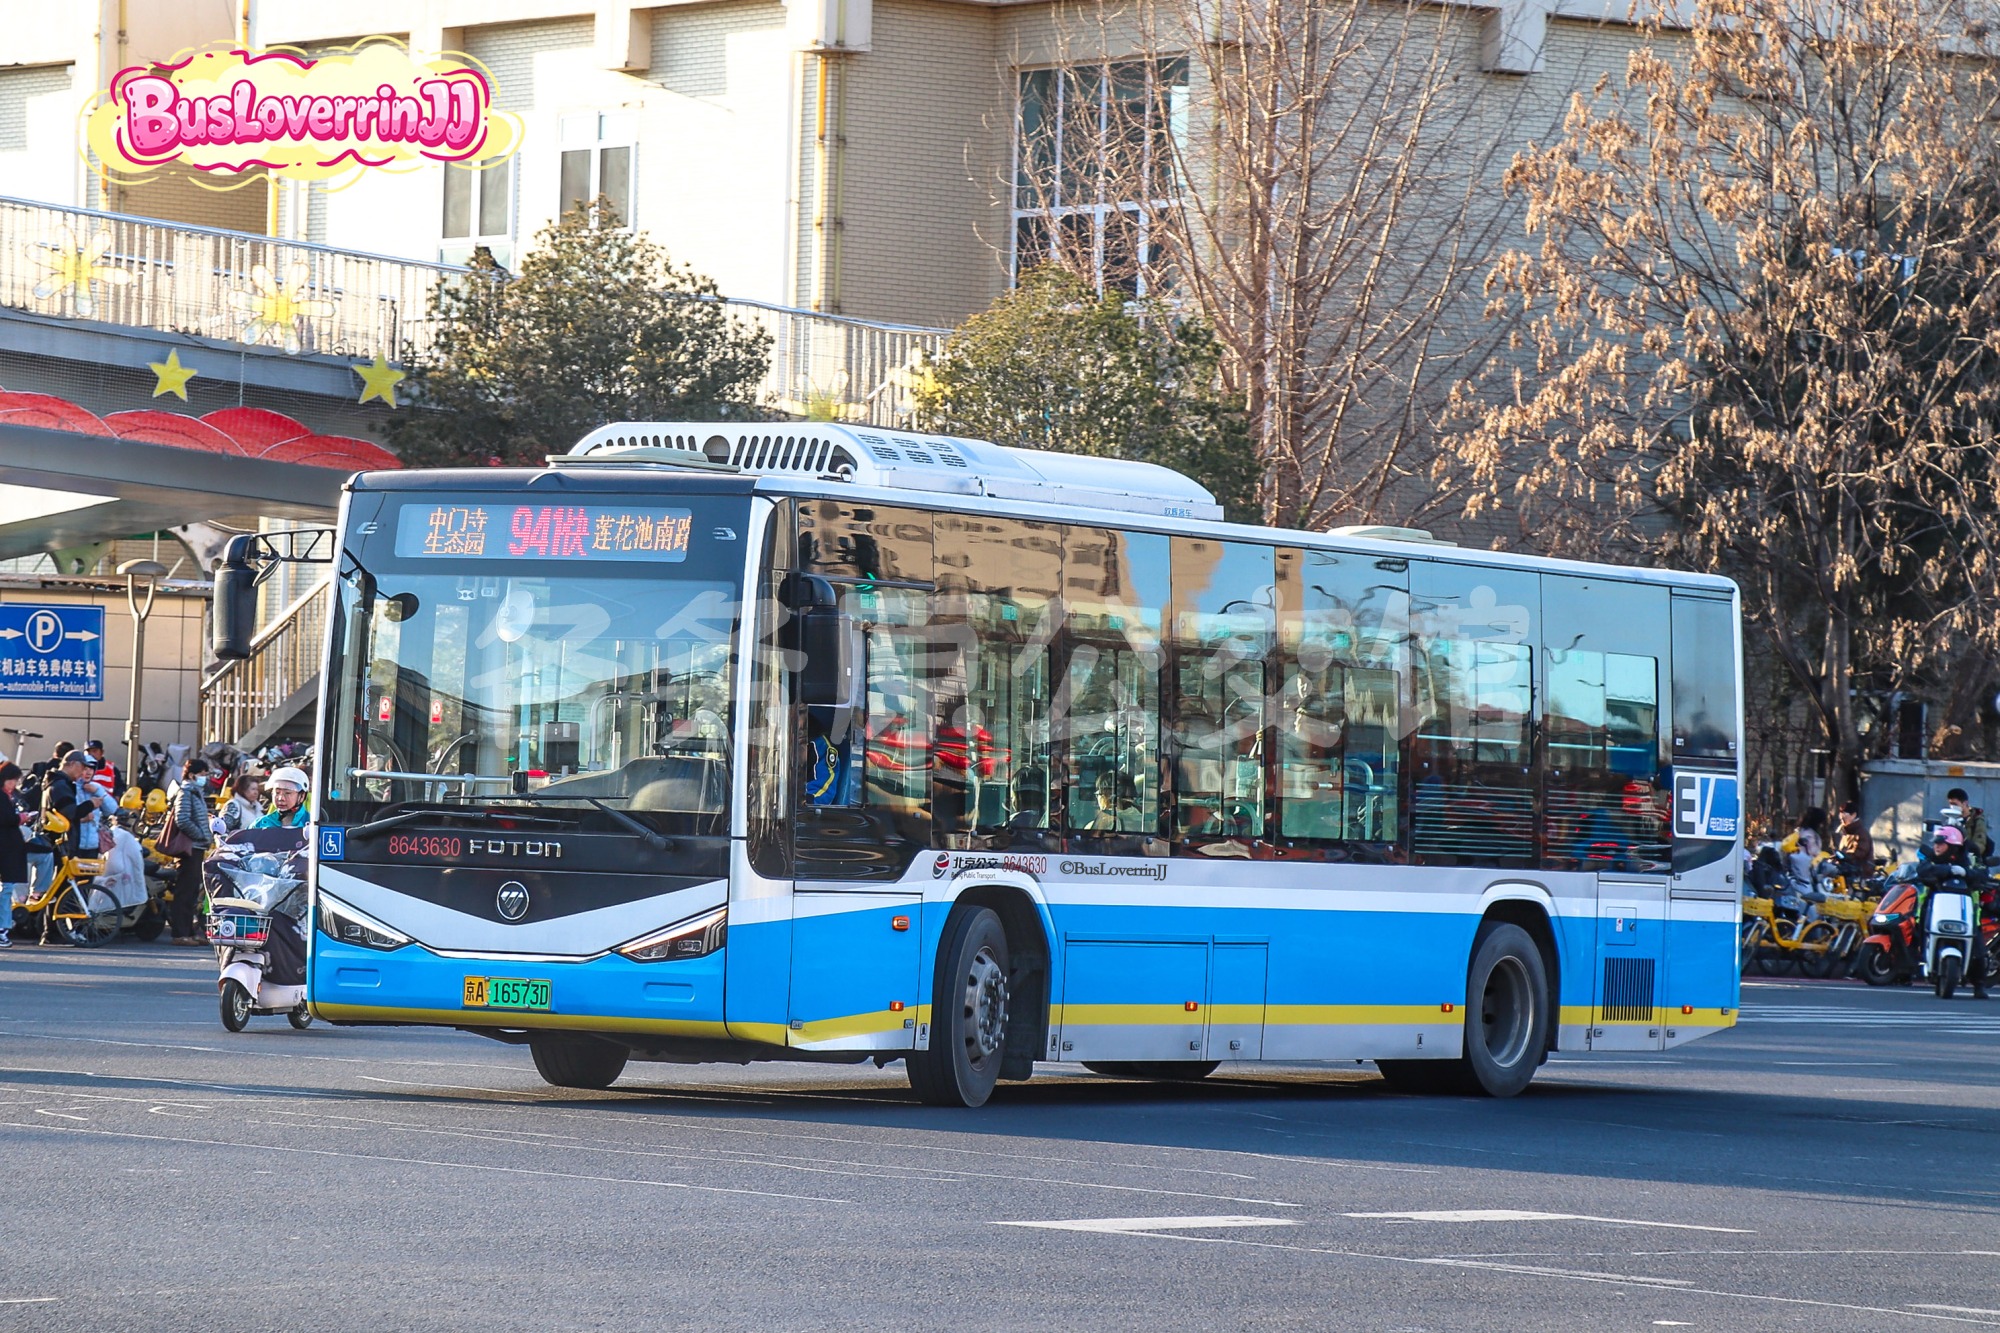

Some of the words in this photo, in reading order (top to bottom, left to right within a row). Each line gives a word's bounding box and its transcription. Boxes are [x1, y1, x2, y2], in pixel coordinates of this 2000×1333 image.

[429, 506, 488, 533] 中门寺
[423, 532, 487, 556] 生态园
[592, 514, 692, 552] 莲花池南路
[36, 615, 55, 648] P
[0, 658, 96, 678] 机动车免费停车处
[45, 681, 60, 692] Free
[60, 681, 85, 696] Parking
[389, 835, 461, 857] 8643630
[469, 839, 561, 858] FOTON
[952, 856, 999, 869] 北京公交
[1001, 855, 1047, 874] 8643630
[976, 872, 996, 880] Transport
[465, 980, 485, 1002] 京A
[493, 982, 549, 1006] 16573D
